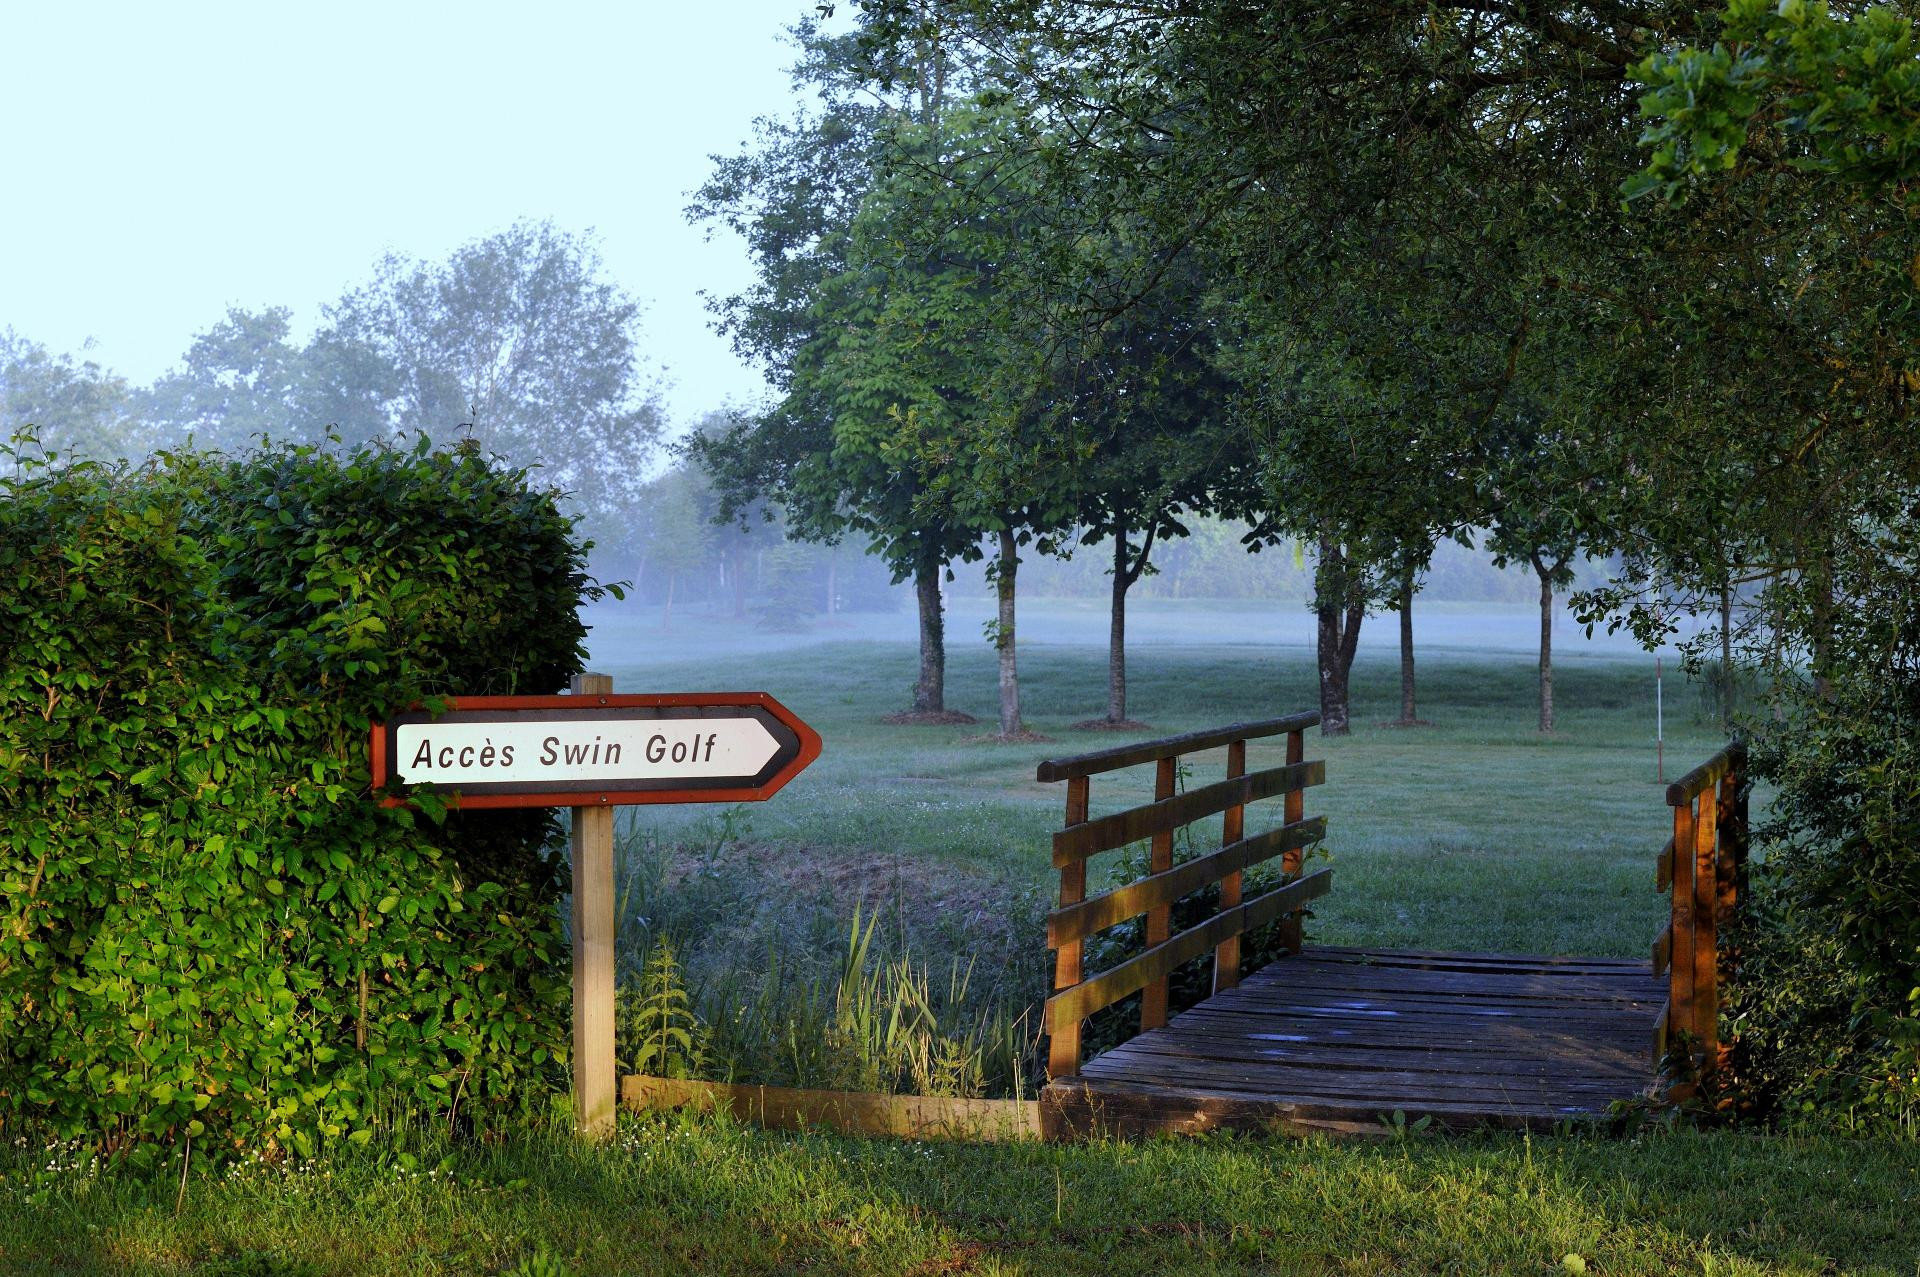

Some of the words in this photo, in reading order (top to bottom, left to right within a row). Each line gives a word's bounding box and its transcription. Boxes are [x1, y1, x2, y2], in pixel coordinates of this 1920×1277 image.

[411, 738, 516, 769] Accès
[539, 735, 622, 766] Swin
[645, 733, 717, 764] Golf
